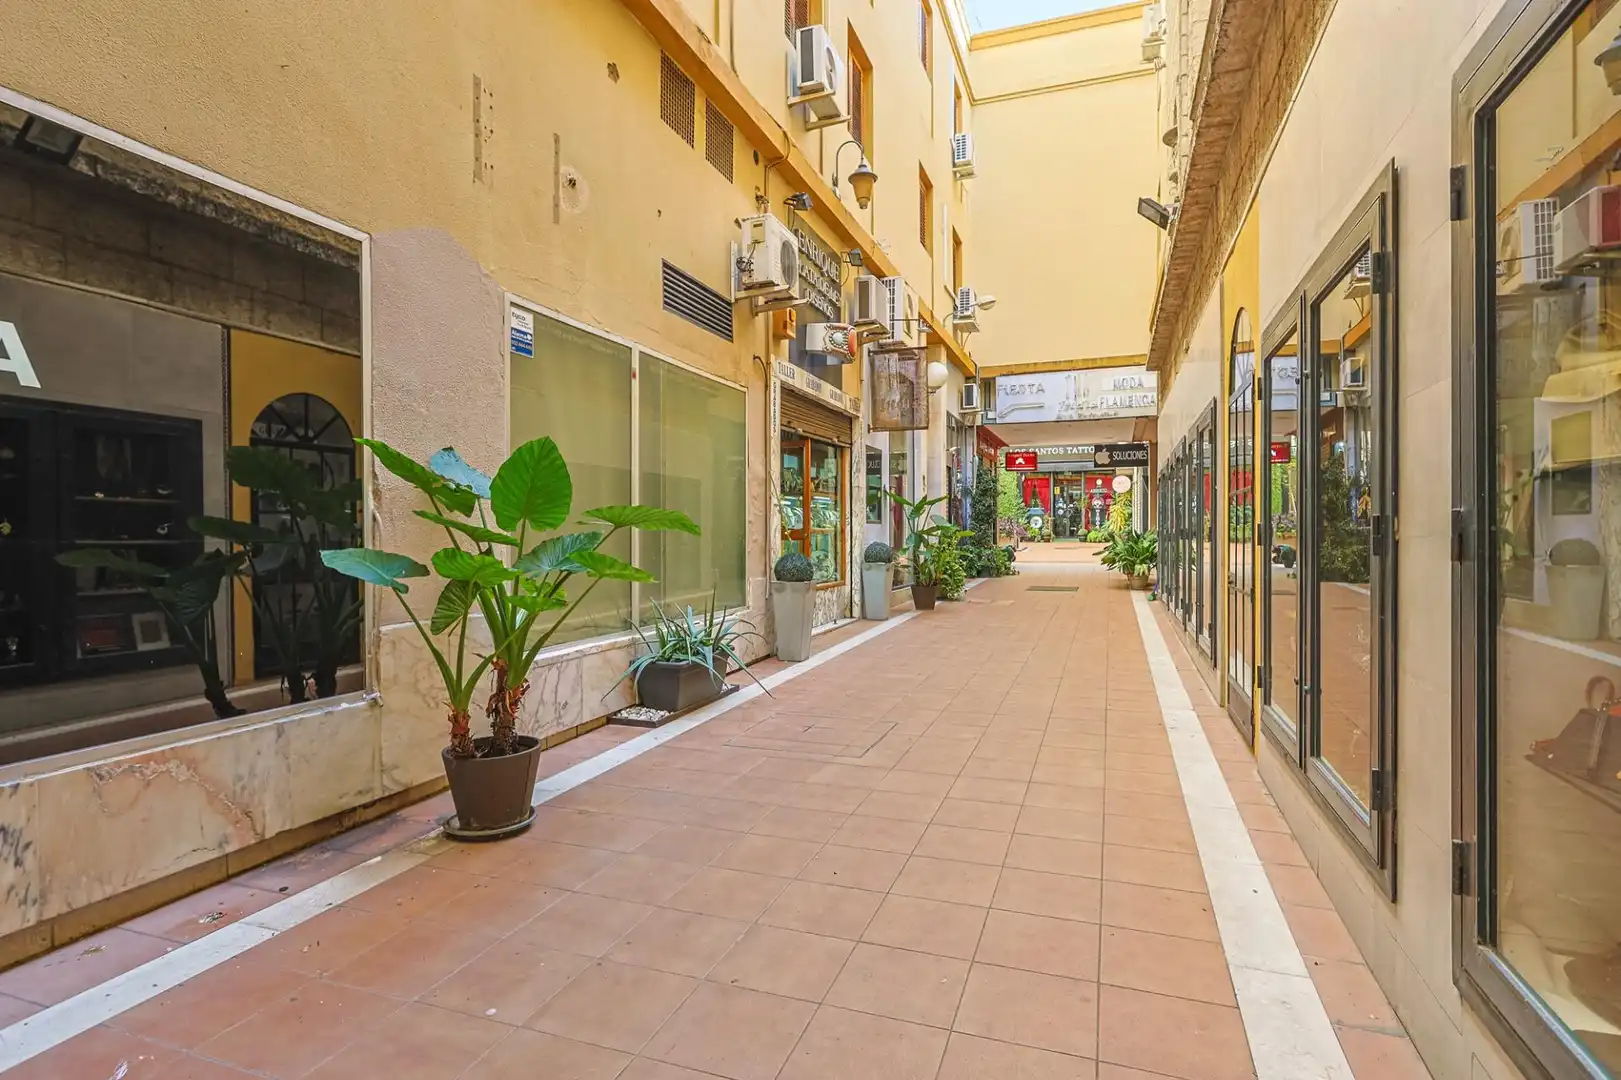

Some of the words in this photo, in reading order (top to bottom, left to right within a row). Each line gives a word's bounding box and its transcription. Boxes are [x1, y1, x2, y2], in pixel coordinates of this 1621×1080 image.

[799, 228, 840, 283] ENRIQUE
[1113, 376, 1145, 391] MODA
[1112, 450, 1148, 460] SOLUCIONES
